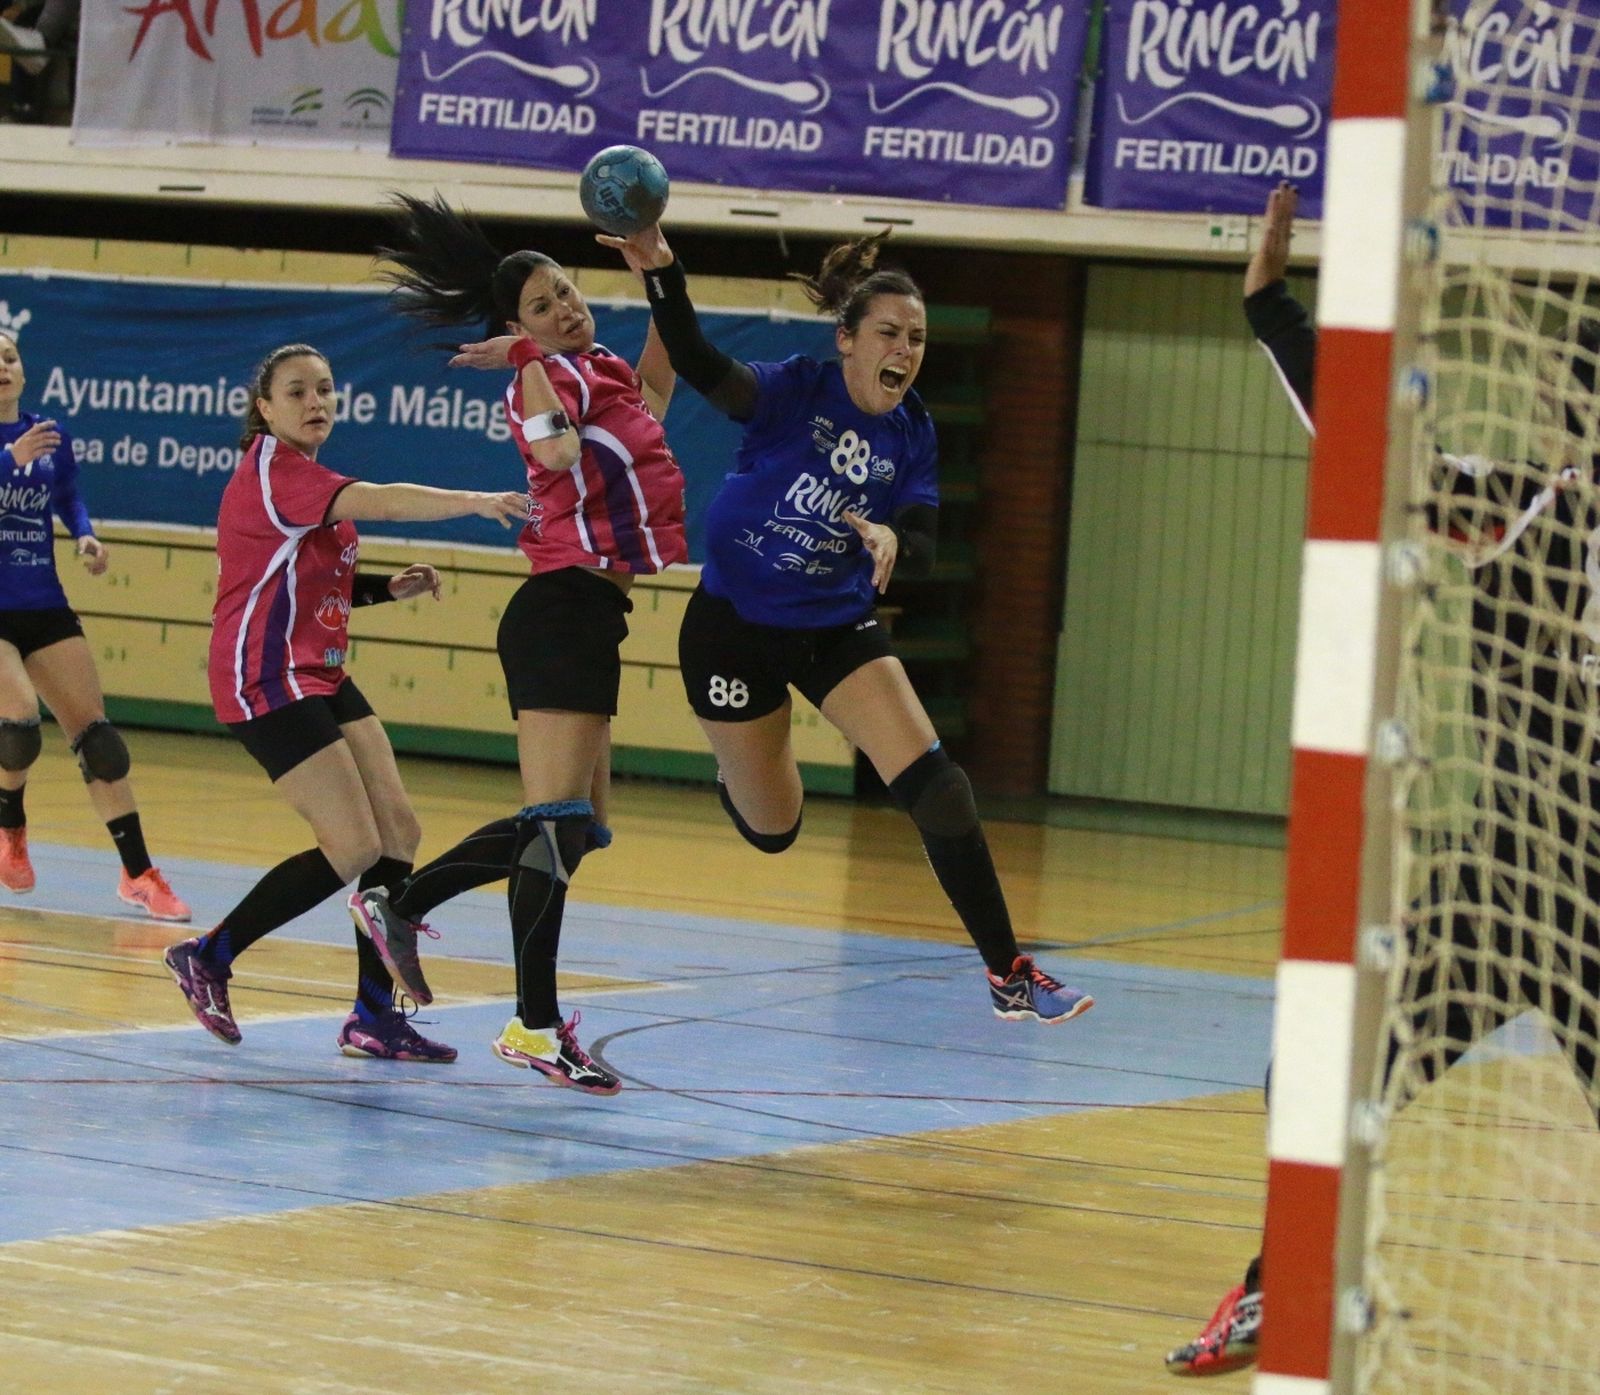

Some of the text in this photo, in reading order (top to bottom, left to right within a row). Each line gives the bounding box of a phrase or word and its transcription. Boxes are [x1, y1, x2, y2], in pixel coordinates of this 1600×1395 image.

[418, 93, 597, 136] FERTILIDAD
[637, 110, 823, 152] FERTILIDAD
[863, 126, 1054, 168] FERTILIDAD
[1114, 137, 1318, 178] FERTILIDAD
[1436, 151, 1570, 188] TILIDAD
[41, 365, 513, 442] Ayuntamie de Málag
[112, 434, 149, 466] de
[831, 430, 870, 485] 88
[708, 674, 750, 708] 88
